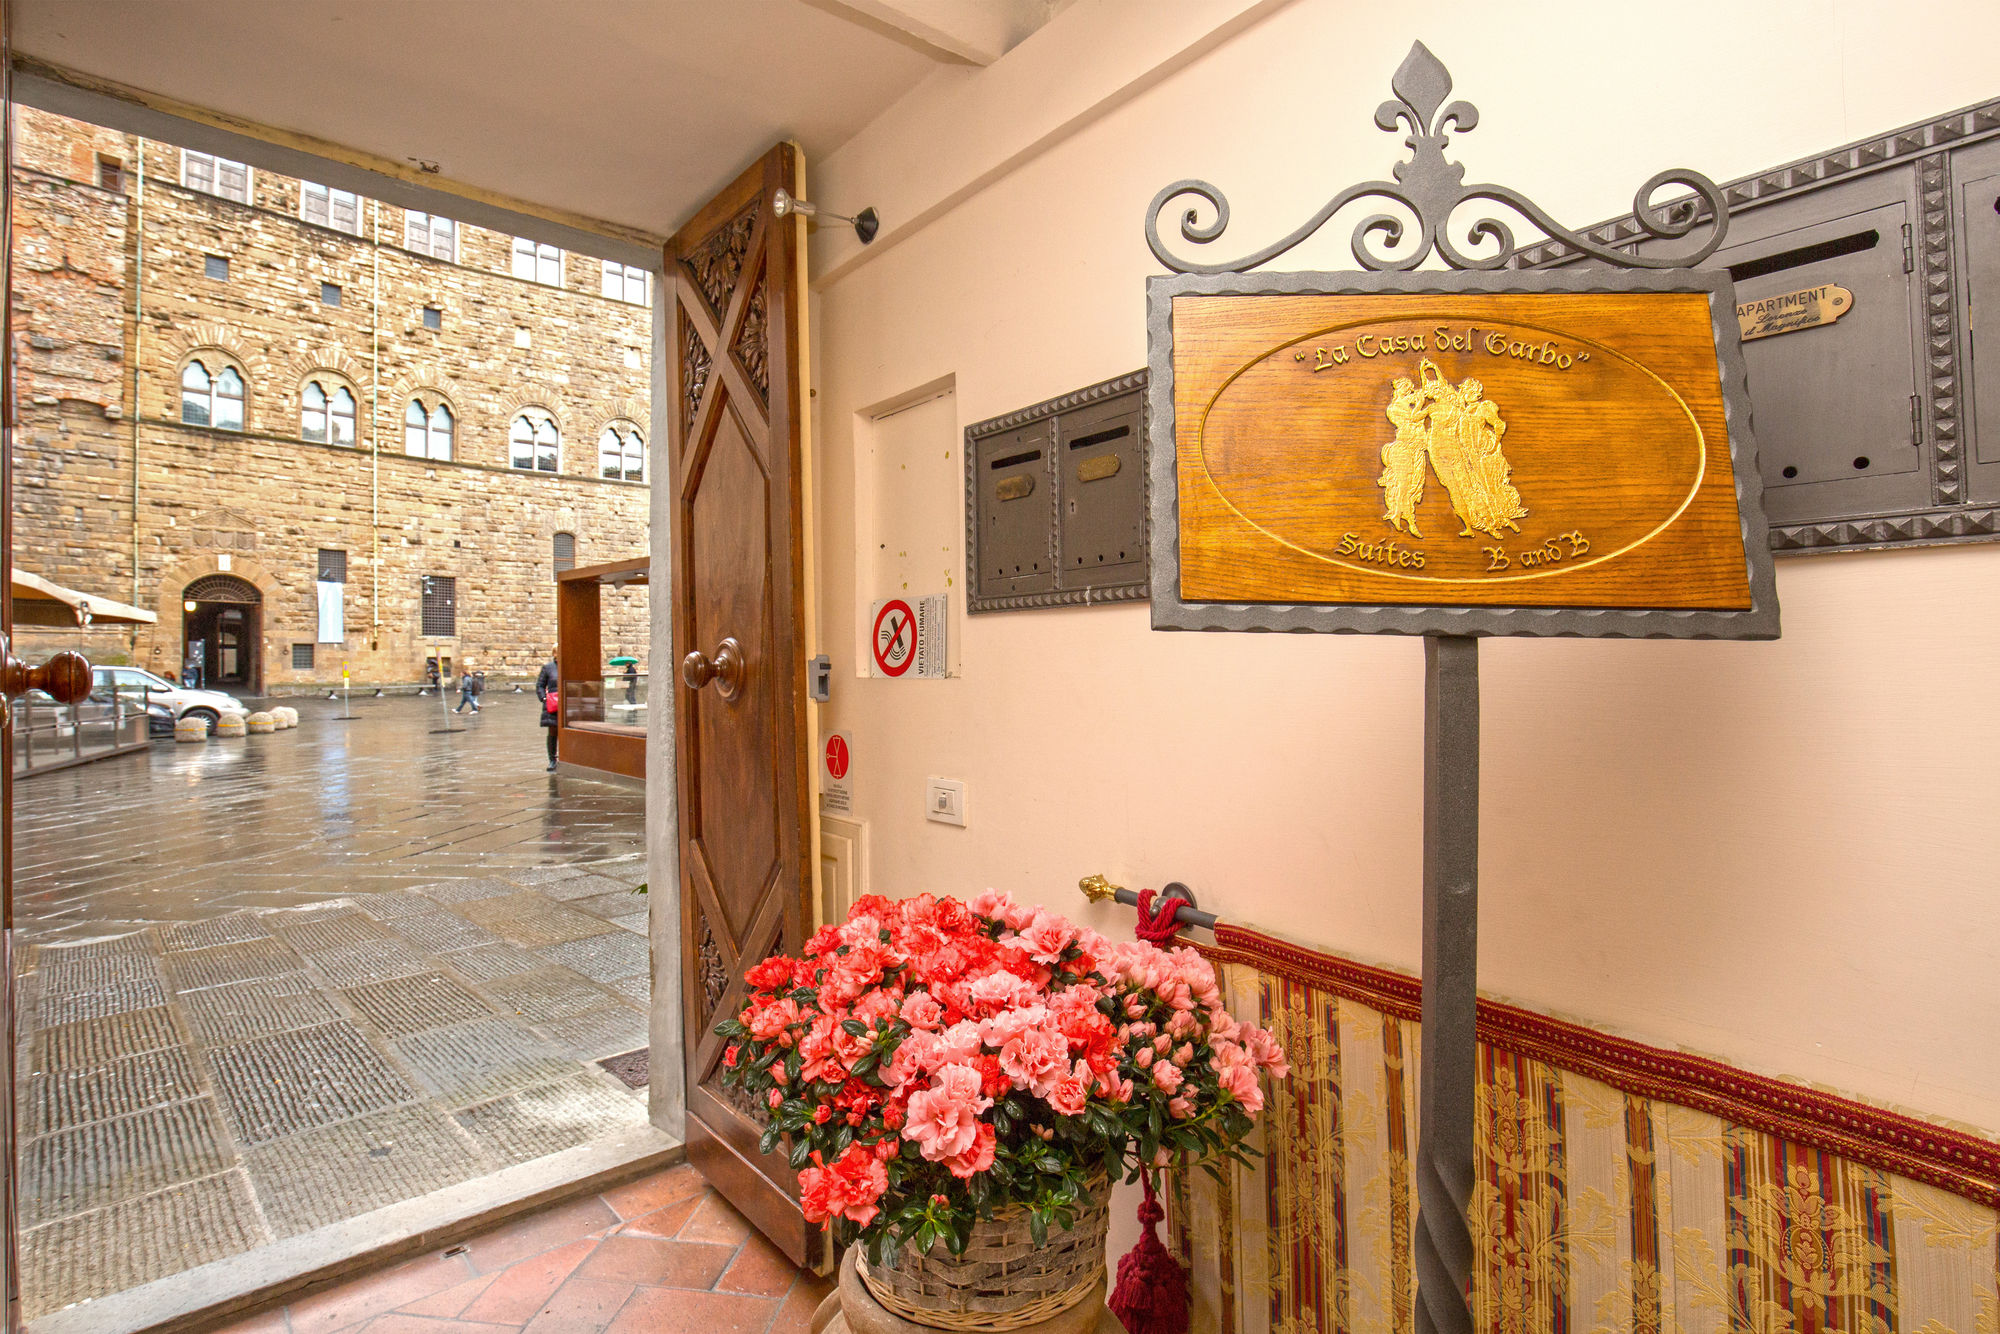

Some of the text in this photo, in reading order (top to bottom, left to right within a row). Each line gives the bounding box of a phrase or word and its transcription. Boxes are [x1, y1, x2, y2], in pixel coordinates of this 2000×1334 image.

[1737, 287, 1827, 318] APARTMENT
[1756, 309, 1808, 324] Lorenzo
[1757, 316, 1820, 333] Magnifico
[1356, 332, 1428, 359] Casa
[1433, 326, 1479, 352] del
[1334, 531, 1426, 569] Suites
[1483, 530, 1591, 572] B and B
[918, 600, 926, 637] FUMARE
